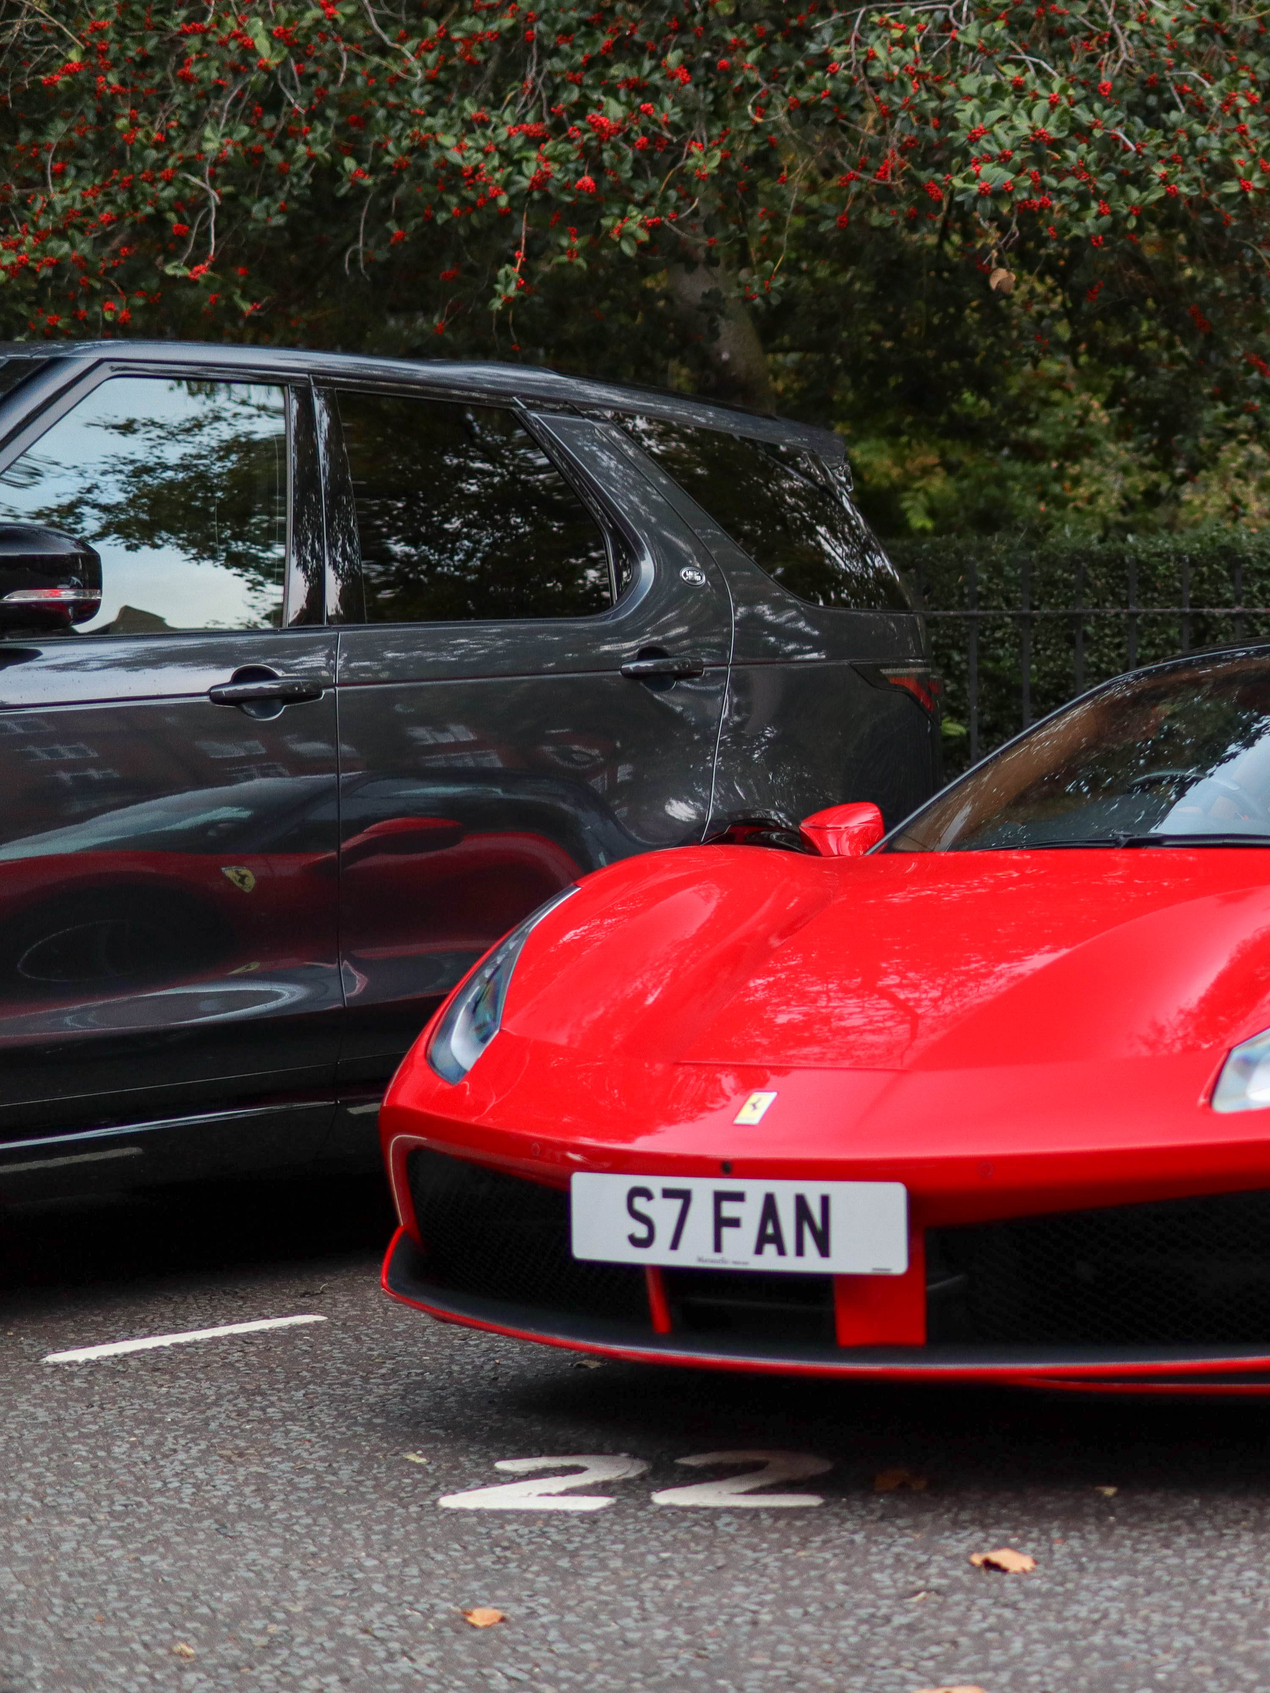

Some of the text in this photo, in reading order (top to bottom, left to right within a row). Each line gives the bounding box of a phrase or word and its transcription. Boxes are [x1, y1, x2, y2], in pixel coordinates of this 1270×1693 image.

[626, 1186, 831, 1258] S7 FAN
[437, 1450, 833, 1511] 22
